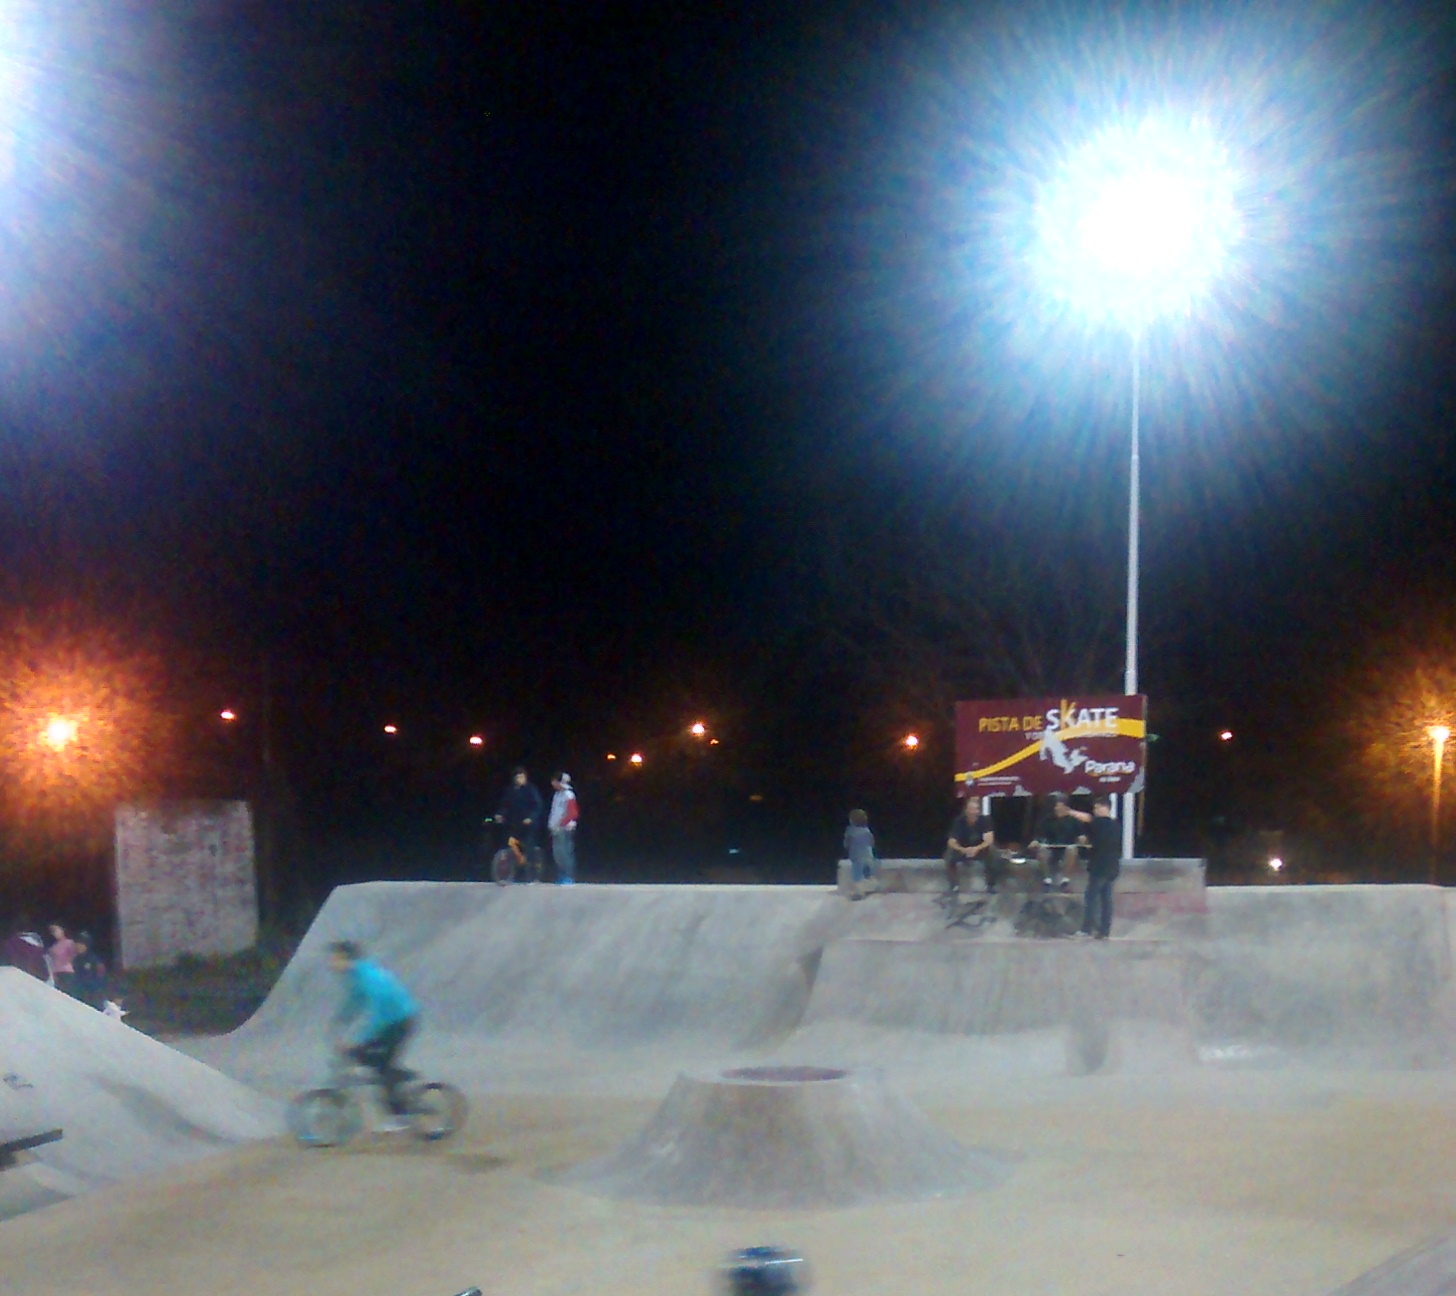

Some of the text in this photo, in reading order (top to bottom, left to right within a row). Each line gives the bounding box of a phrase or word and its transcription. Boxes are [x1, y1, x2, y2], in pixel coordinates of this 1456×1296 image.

[979, 699, 1119, 732] PISTA DE SKATE
